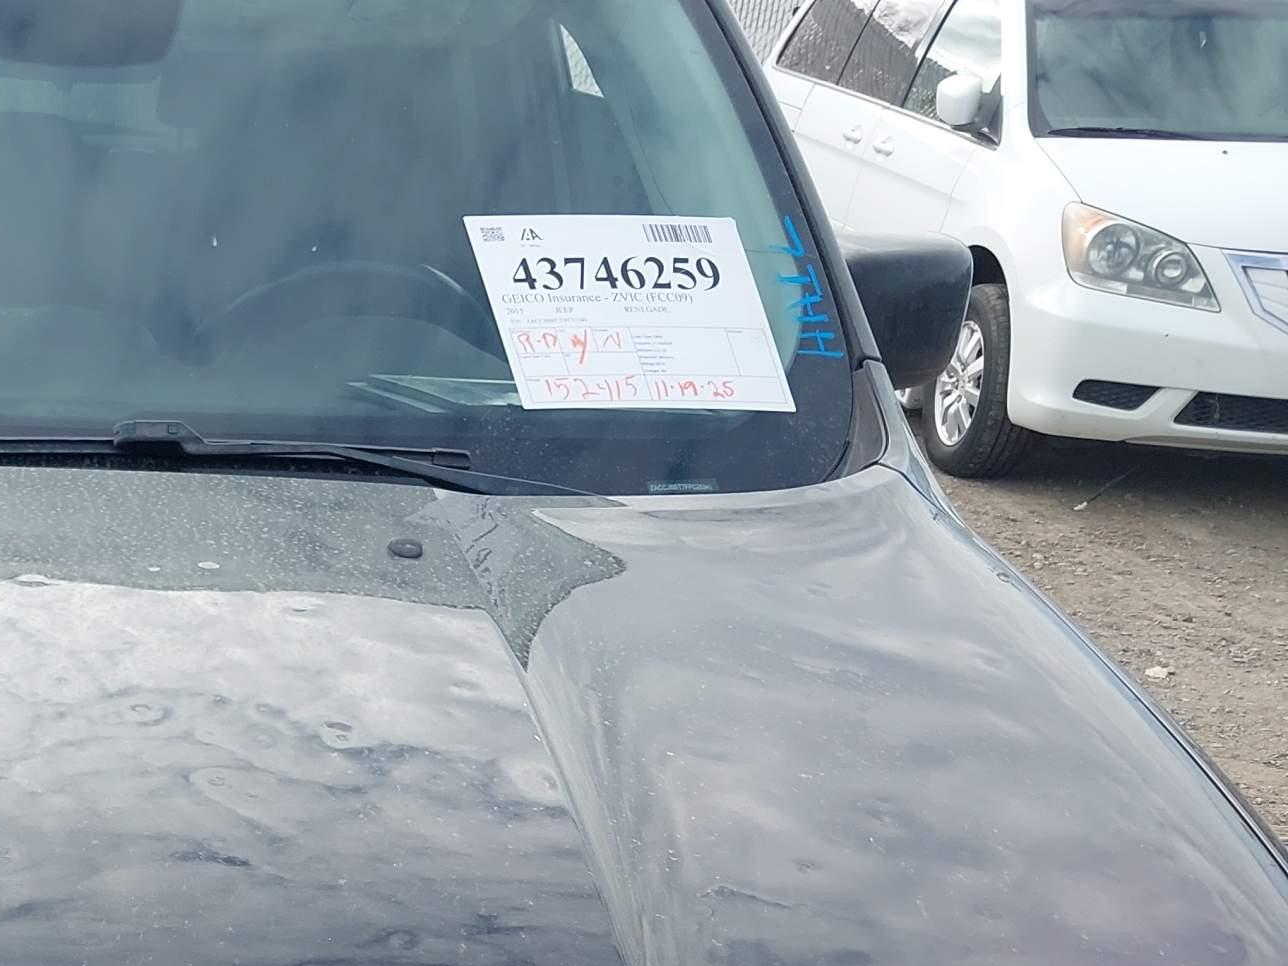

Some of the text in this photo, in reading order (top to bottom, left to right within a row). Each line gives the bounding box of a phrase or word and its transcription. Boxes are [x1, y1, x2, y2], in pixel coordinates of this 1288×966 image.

[512, 256, 721, 292] 43746259
[501, 293, 545, 304] GEICO
[548, 293, 601, 303] Insurance
